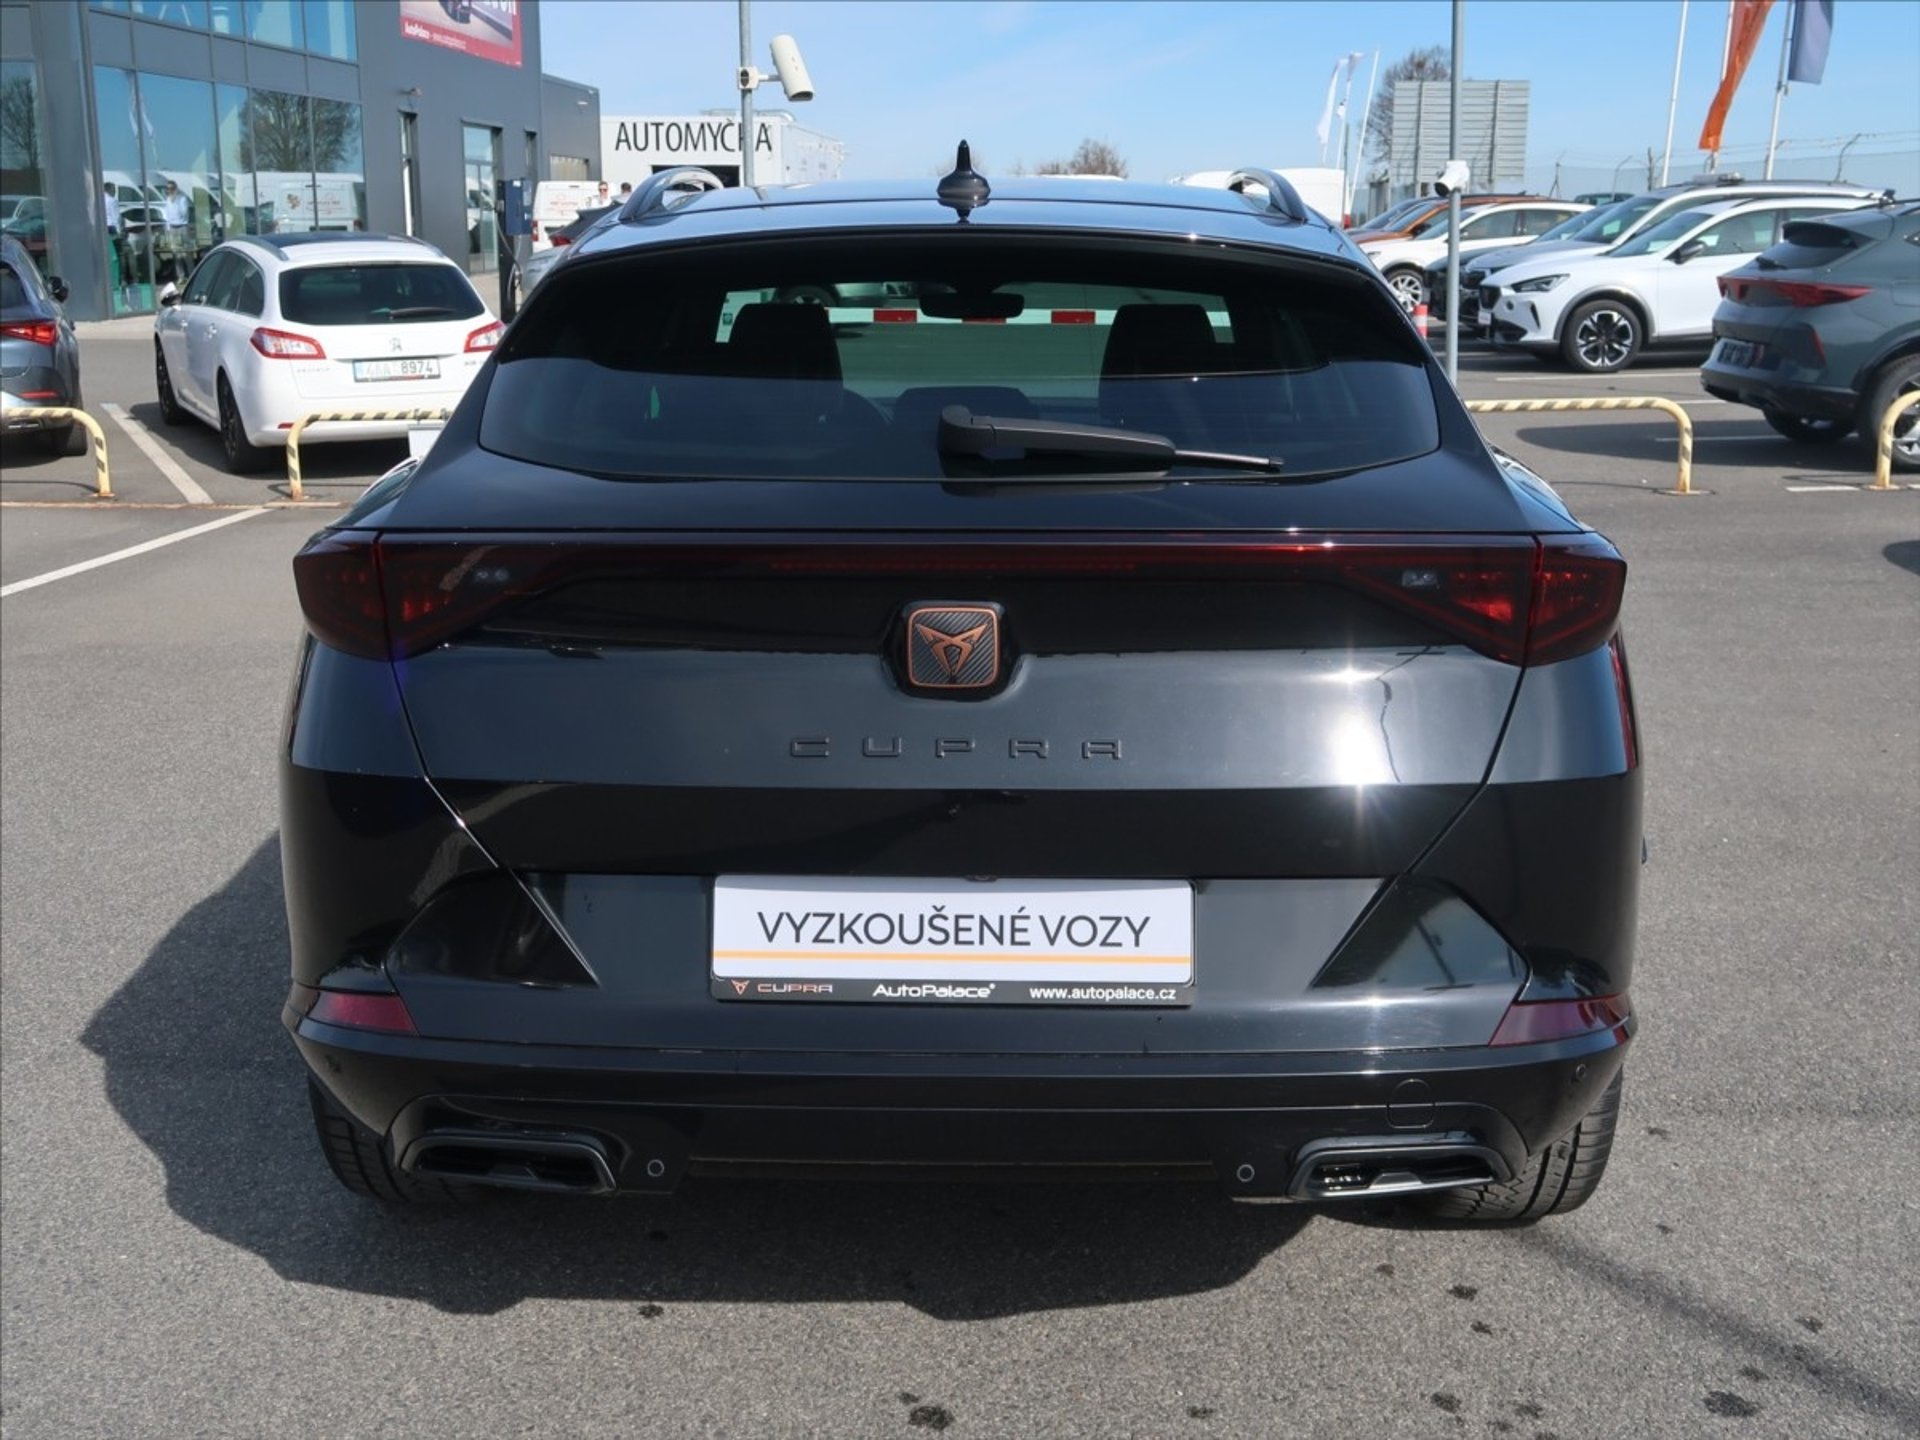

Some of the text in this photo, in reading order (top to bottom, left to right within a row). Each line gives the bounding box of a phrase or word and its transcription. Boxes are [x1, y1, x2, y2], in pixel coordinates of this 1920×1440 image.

[400, 360, 433, 374] 8974
[790, 737, 1122, 759] CUPRA
[757, 905, 1151, 948] VYZKOUŠENÉ VOZY
[757, 983, 833, 993] CUPRA
[1029, 986, 1176, 1001] www.autopalace.cz
